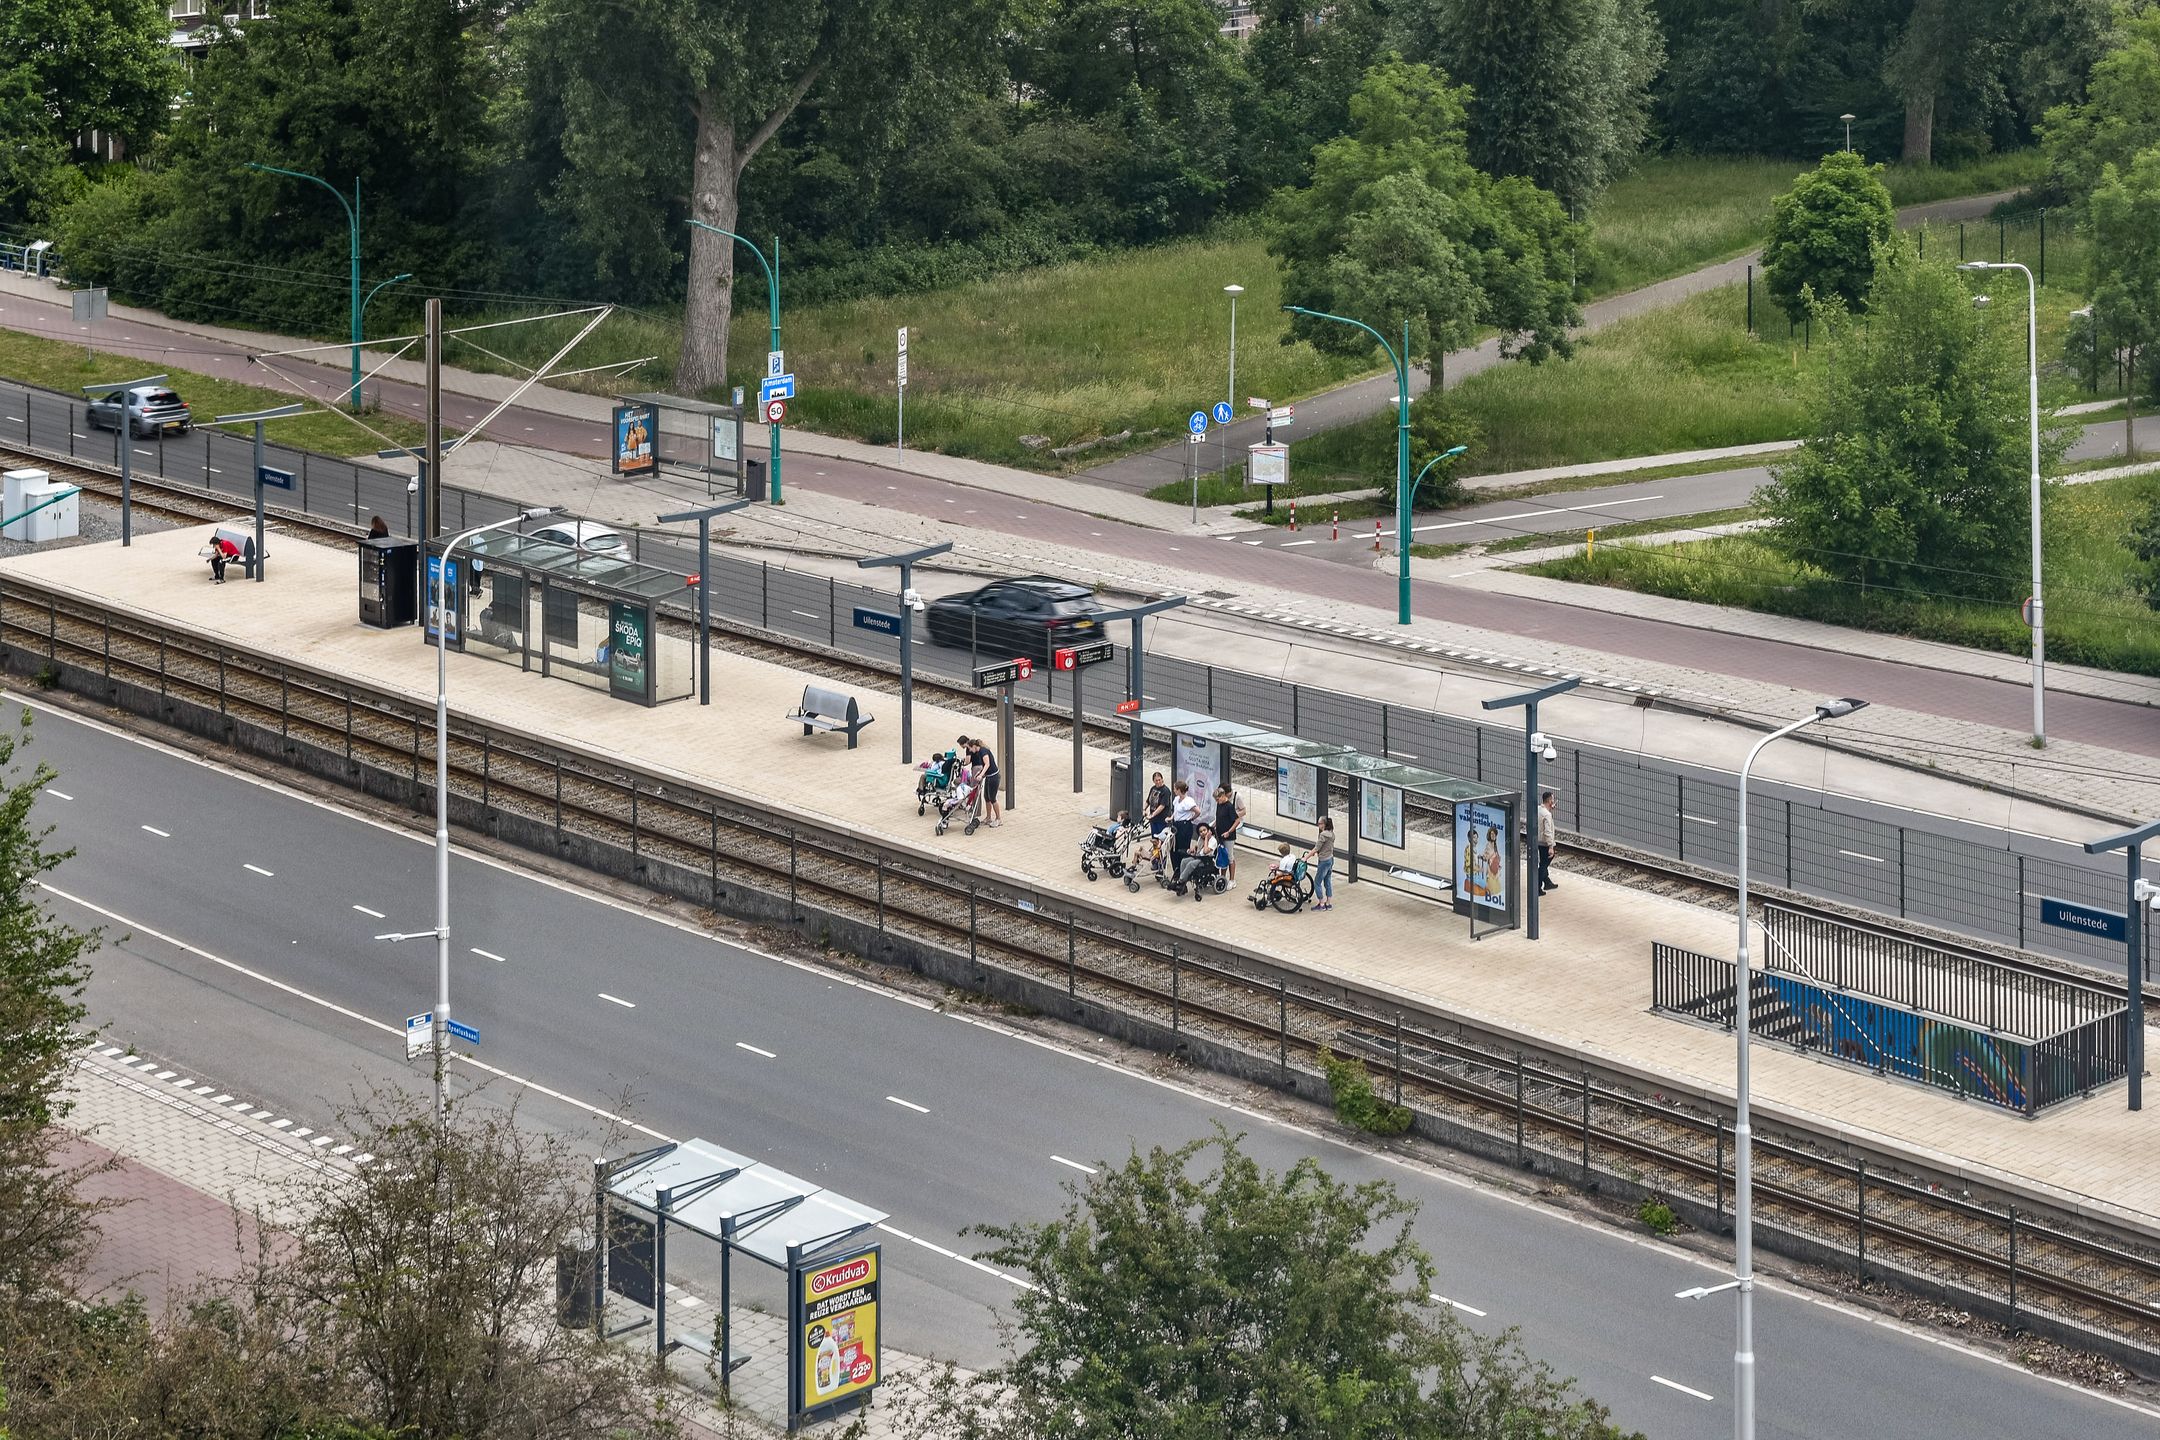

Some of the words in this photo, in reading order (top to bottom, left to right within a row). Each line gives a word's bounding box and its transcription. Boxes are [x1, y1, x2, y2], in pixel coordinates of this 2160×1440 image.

[764, 377, 793, 387] Amsterdam
[771, 407, 782, 415] 50
[863, 615, 891, 629] Uilenstede
[615, 621, 638, 638] ŠKODA
[626, 635, 642, 648] EPIQ
[1464, 809, 1489, 820] mteen
[1485, 893, 1505, 906] bol.
[2059, 911, 2108, 931] Uilenstede
[826, 1263, 866, 1286] Kruidvat
[816, 1300, 829, 1311] DAT
[829, 1291, 852, 1307] WORDT
[852, 1288, 865, 1298] EEN
[809, 1307, 829, 1321] REUZE
[830, 1293, 872, 1313] VERJAARDAG
